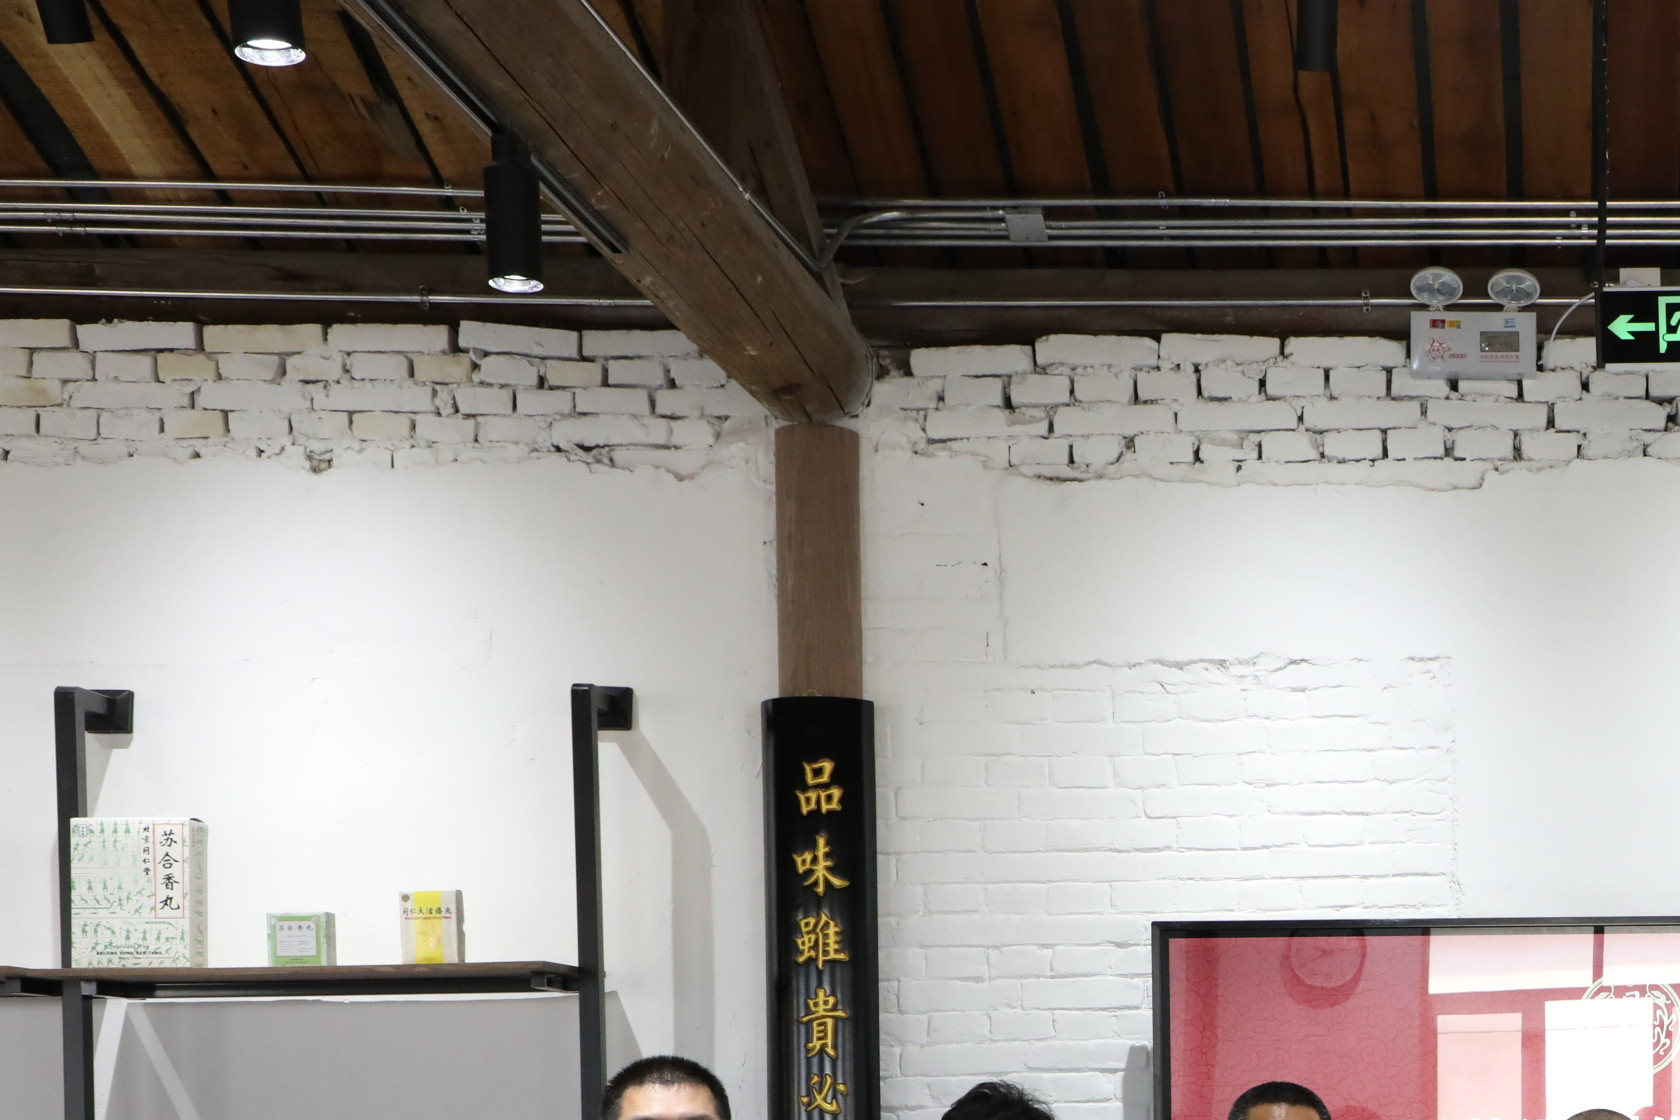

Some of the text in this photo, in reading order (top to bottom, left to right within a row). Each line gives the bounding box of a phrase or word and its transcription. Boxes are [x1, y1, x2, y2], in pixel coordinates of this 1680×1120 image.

[141, 825, 151, 876] 北京同仁堂
[157, 829, 180, 911] 苏合香丸
